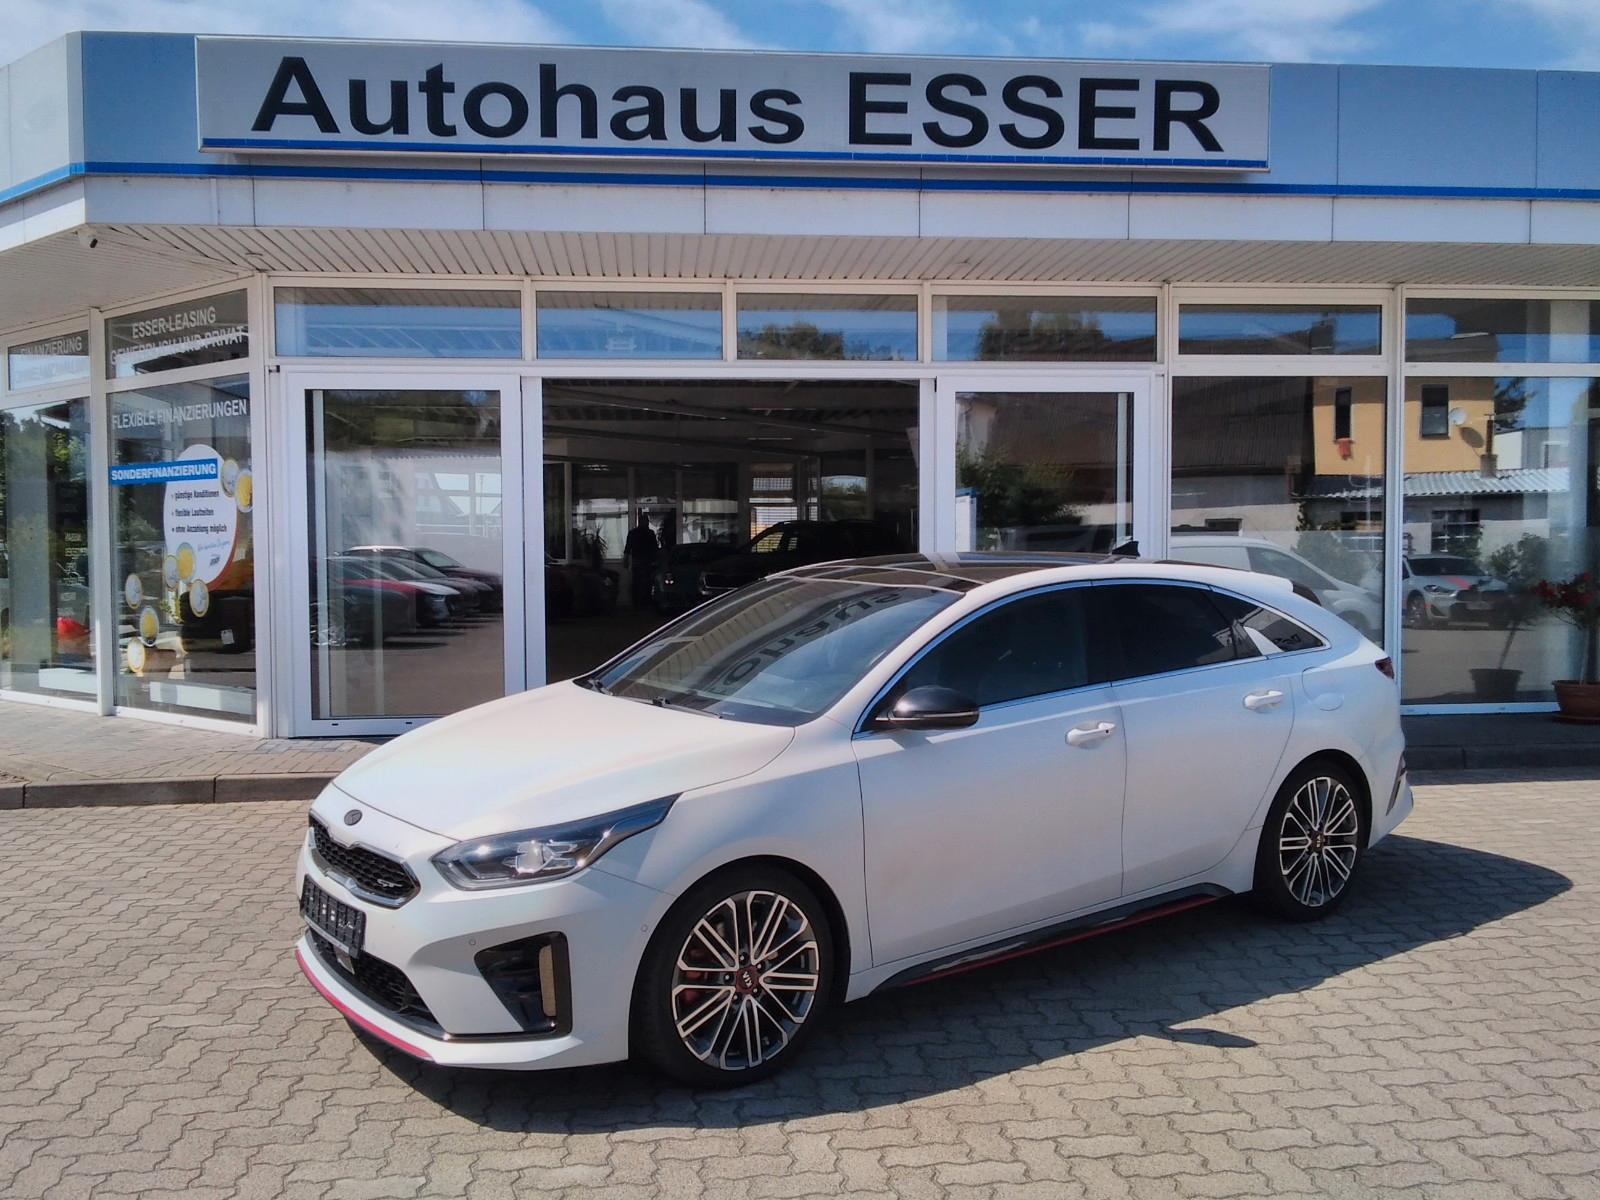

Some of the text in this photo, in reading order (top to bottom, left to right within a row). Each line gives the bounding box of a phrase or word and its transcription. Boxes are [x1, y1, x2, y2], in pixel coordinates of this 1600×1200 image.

[251, 56, 1225, 152] Autohaus ESSER
[132, 306, 216, 339] ESSER-LEASING
[112, 399, 248, 430] FLEXIBLE FINANZIERUNGEN
[111, 463, 217, 480] SONDERFINANZIERUNG
